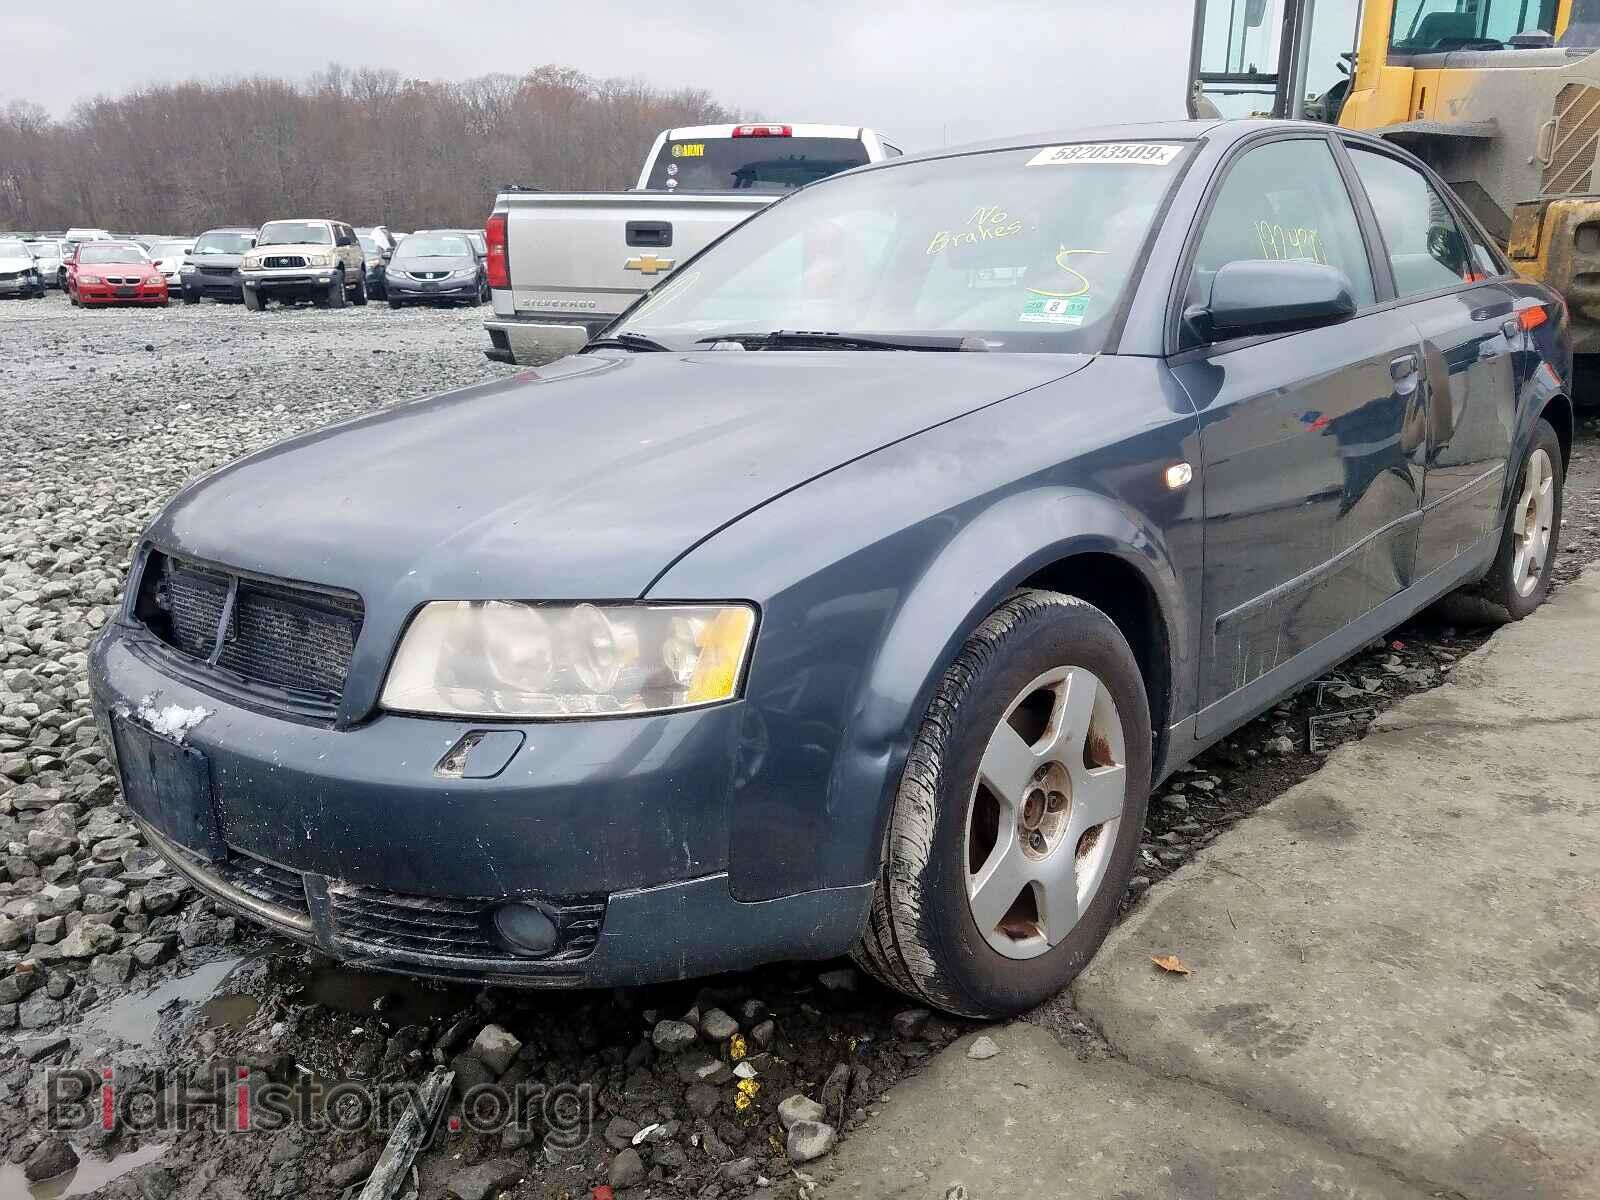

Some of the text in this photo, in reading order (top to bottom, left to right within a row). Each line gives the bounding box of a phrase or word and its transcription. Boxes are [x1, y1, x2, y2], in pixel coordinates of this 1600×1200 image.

[682, 144, 705, 157] ARMY
[967, 205, 1008, 224] No
[521, 299, 597, 309] SILVERADO
